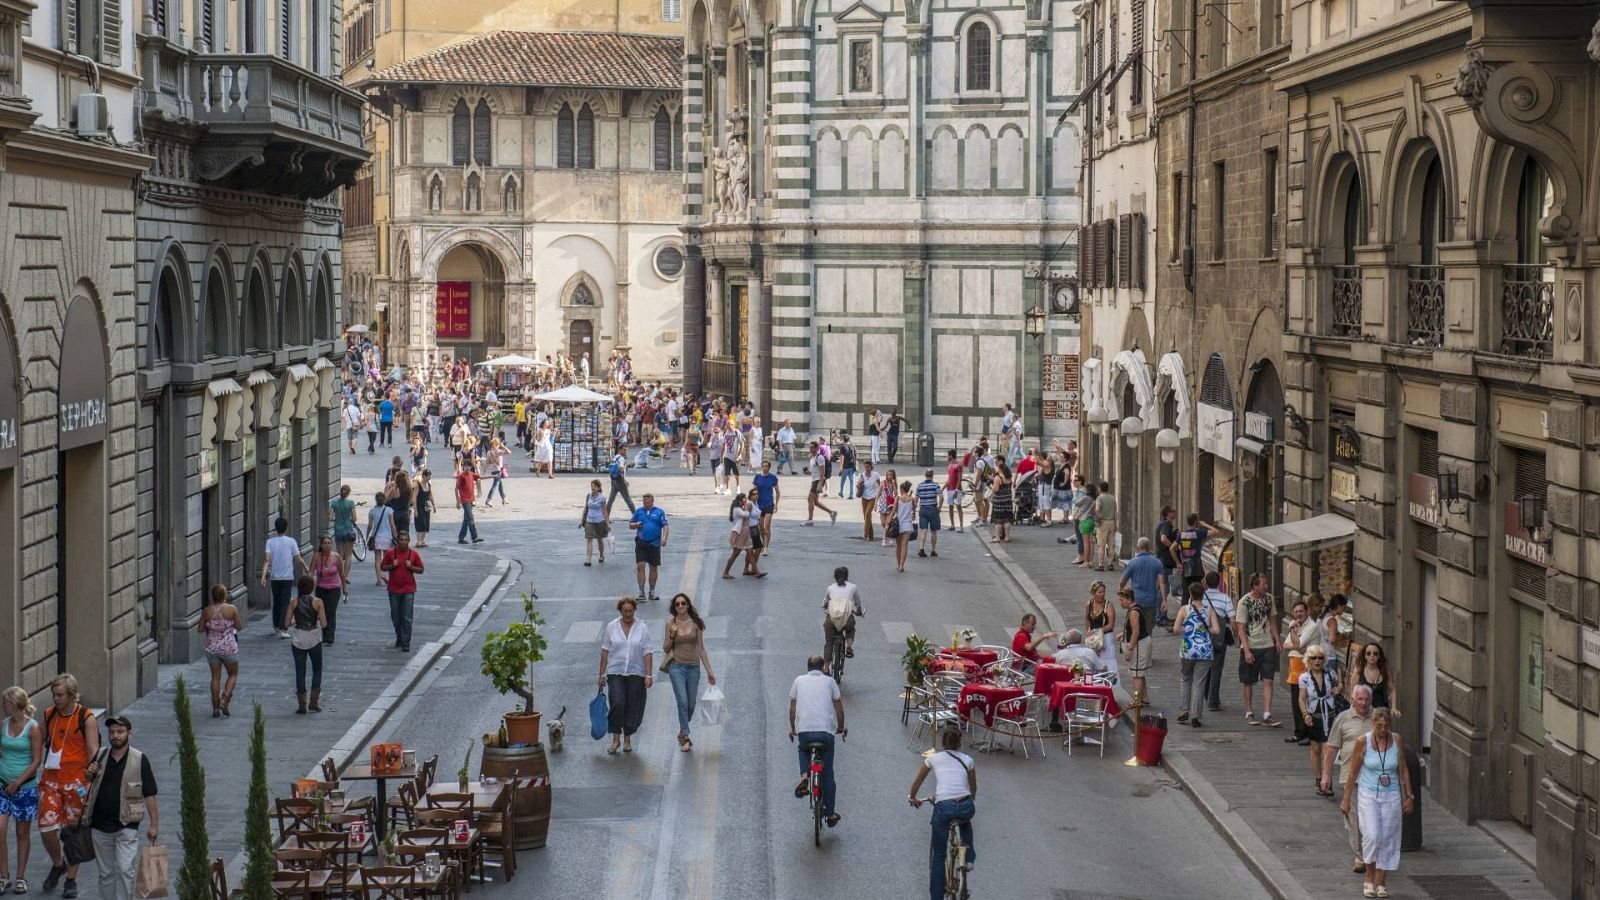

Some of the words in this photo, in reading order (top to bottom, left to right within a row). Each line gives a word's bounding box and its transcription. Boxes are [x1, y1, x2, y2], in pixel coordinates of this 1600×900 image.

[61, 398, 107, 432] SEPHORA
[1505, 534, 1527, 557] BANCA
[1527, 541, 1537, 561] CR
